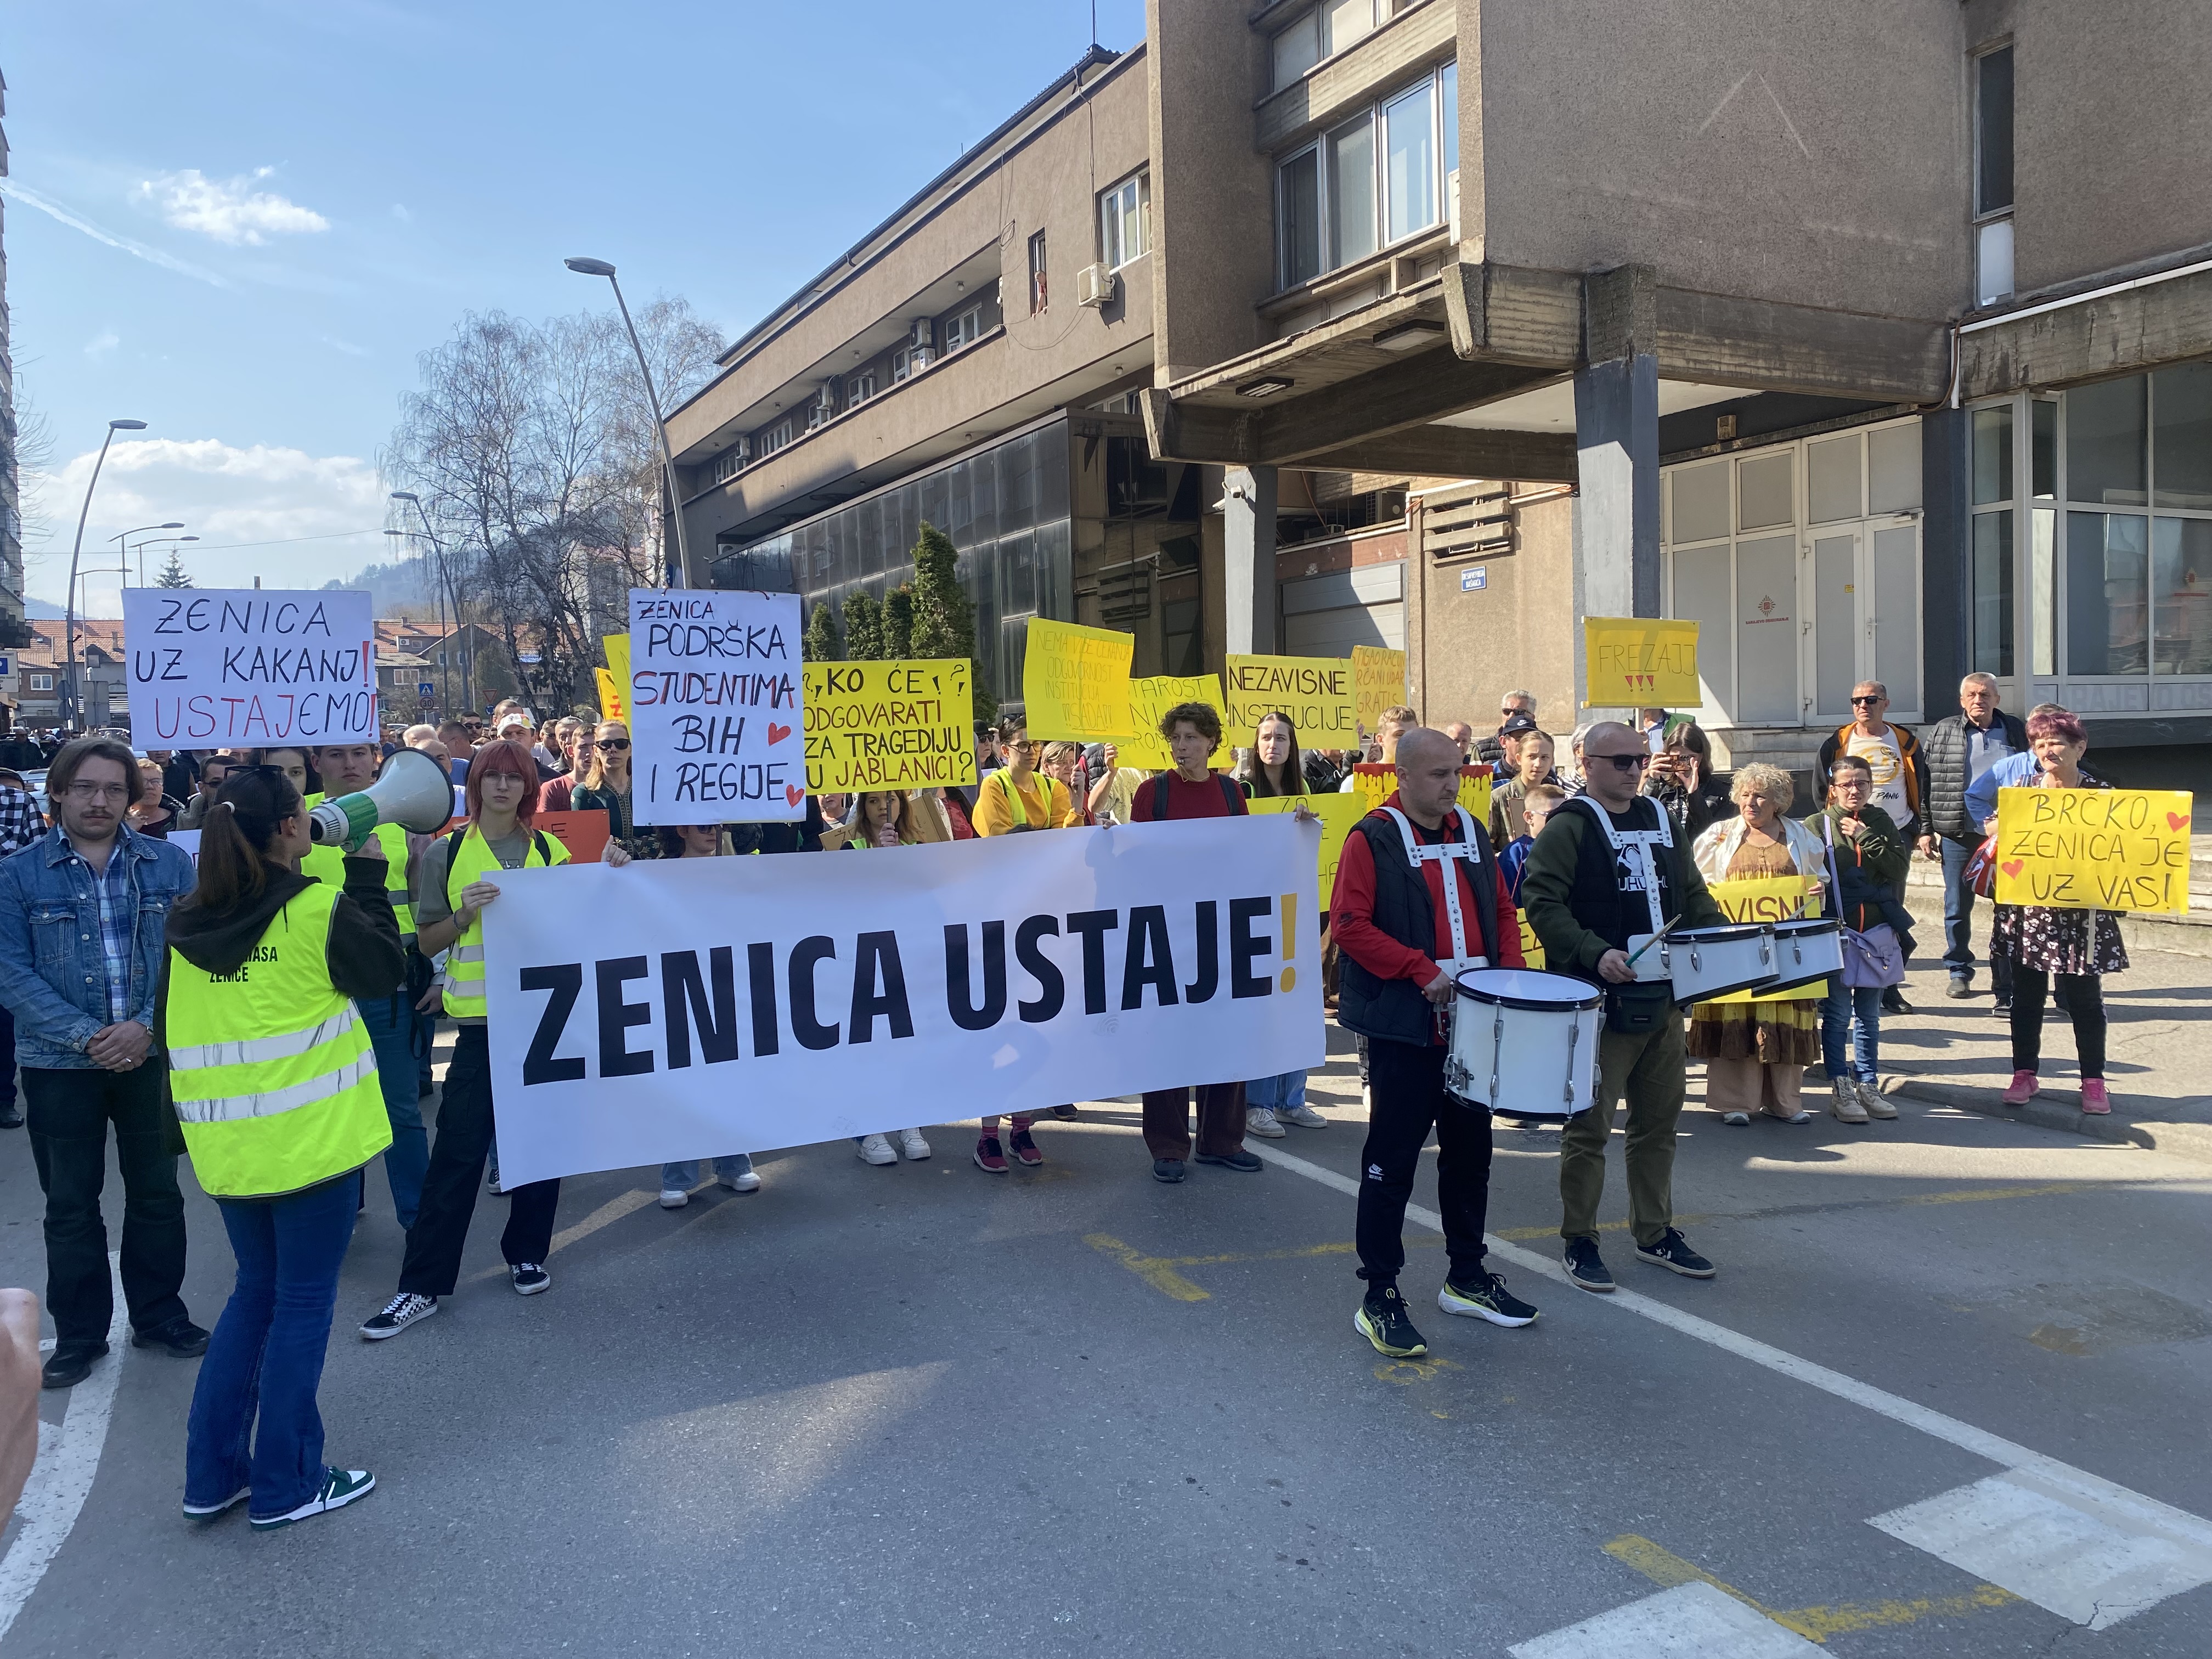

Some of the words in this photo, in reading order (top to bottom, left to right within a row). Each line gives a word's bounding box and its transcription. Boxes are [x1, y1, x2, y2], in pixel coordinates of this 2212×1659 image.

[154, 599, 331, 636] ZENICA
[637, 600, 714, 620] ZENICA
[648, 619, 787, 659] PODRŠKA
[1036, 630, 1068, 653] NEMA
[1073, 632, 1093, 654] VIŠE
[1097, 636, 1130, 662] ČEKANJA
[136, 649, 188, 682] UZ
[223, 641, 370, 687] KAKANJ!
[1047, 657, 1114, 682] ODGOVORNOST
[1355, 667, 1385, 687] RČANI
[1599, 644, 1696, 676] FREZAJJ
[633, 670, 795, 709] STUDENTIMA
[827, 668, 865, 696] KO
[887, 663, 924, 693] ĆE
[1045, 680, 1099, 701] INSTITUCIJA
[1128, 677, 1206, 698] TAROST
[1229, 665, 1347, 695] NEZAVISNE
[155, 692, 377, 739] USTAJEMO!
[803, 699, 941, 731] ODGOVARATI
[1229, 703, 1353, 731] INSTTUCIJE
[672, 714, 746, 755] BIH
[804, 735, 836, 759] ZA
[843, 726, 961, 757] TRAGEDIJU
[651, 764, 657, 803] I
[675, 763, 788, 802] REGIJE
[806, 764, 823, 789] U
[836, 752, 973, 787] JABLANICI?
[2029, 792, 2156, 834] BRČKO,
[2010, 830, 2126, 863] ZENICA
[2140, 837, 2184, 868] JE
[2032, 873, 2081, 902] UZ
[2097, 873, 2172, 910] VAS!
[520, 930, 914, 1086] ZENICA
[945, 893, 1297, 1031] USTAJE!
